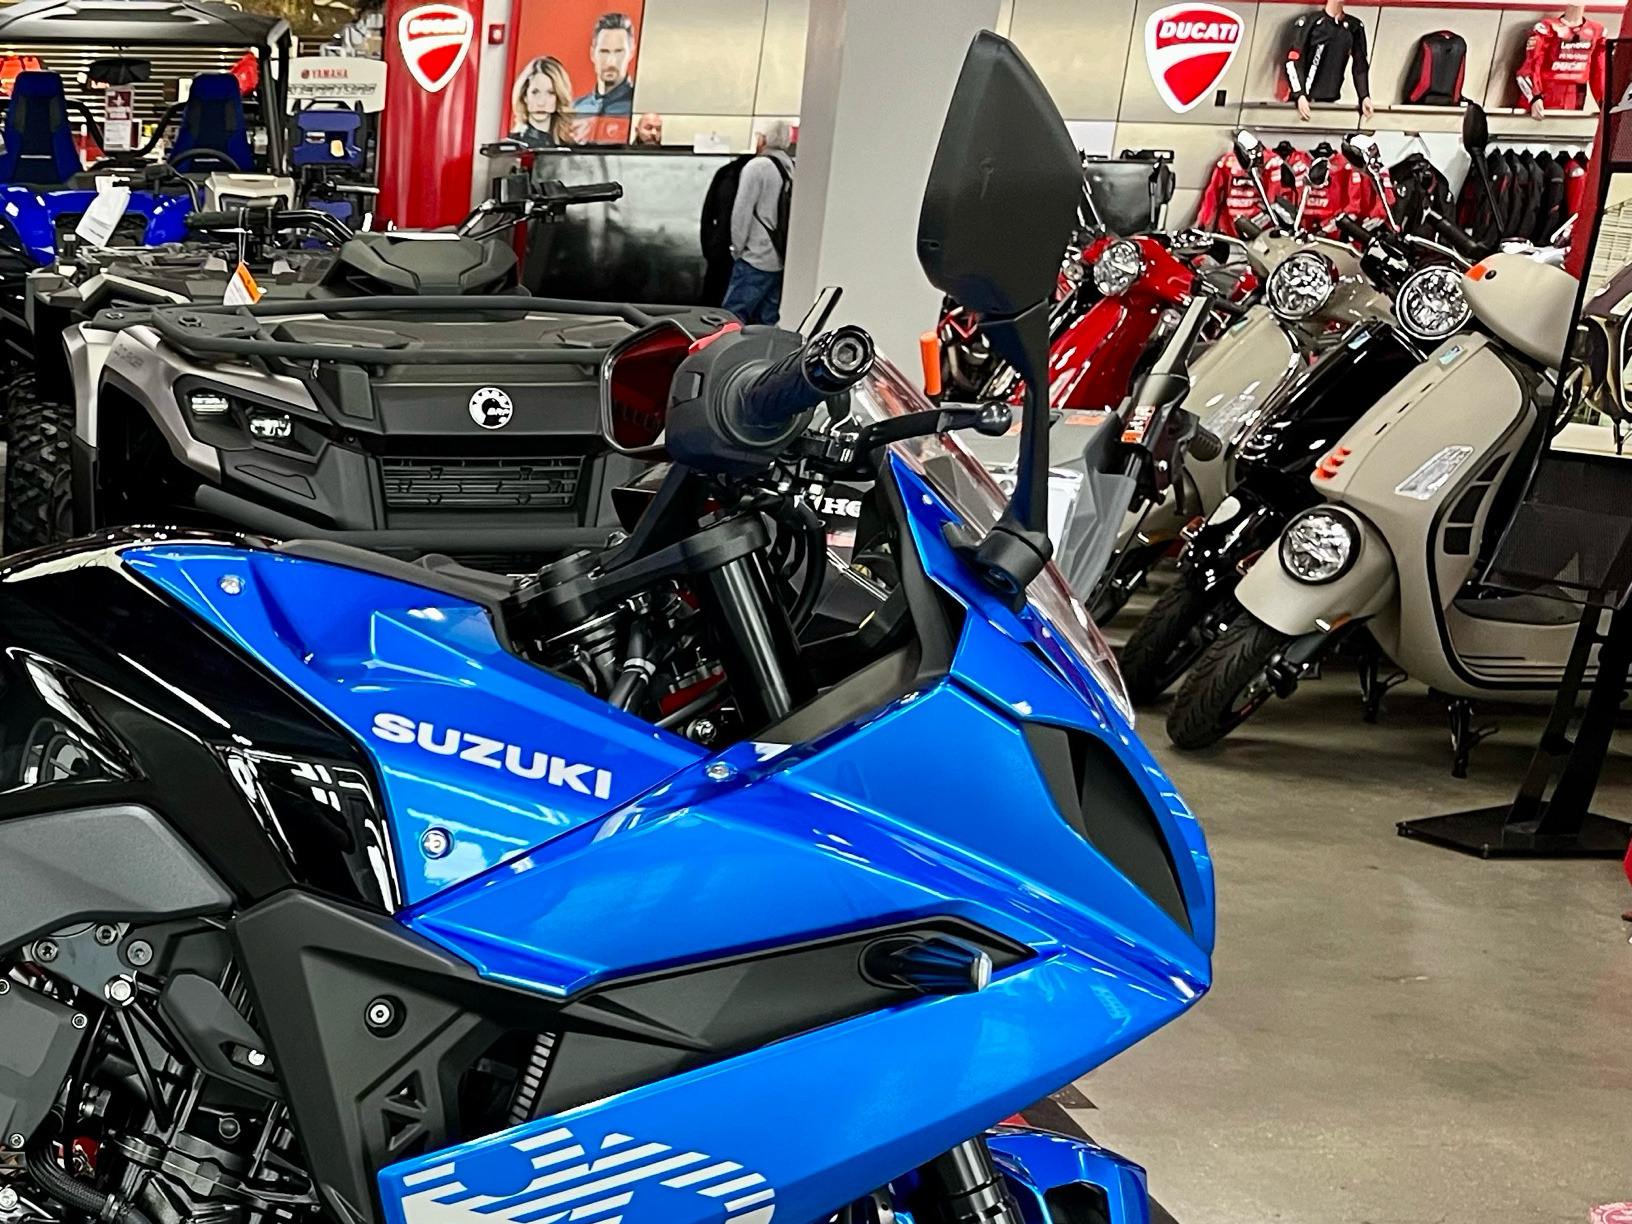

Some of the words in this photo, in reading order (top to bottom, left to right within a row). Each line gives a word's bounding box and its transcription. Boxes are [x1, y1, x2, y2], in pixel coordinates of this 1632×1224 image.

[1159, 21, 1238, 41] DUCATI
[312, 69, 349, 79] YAMAHA
[371, 713, 612, 799] SUZUKI
